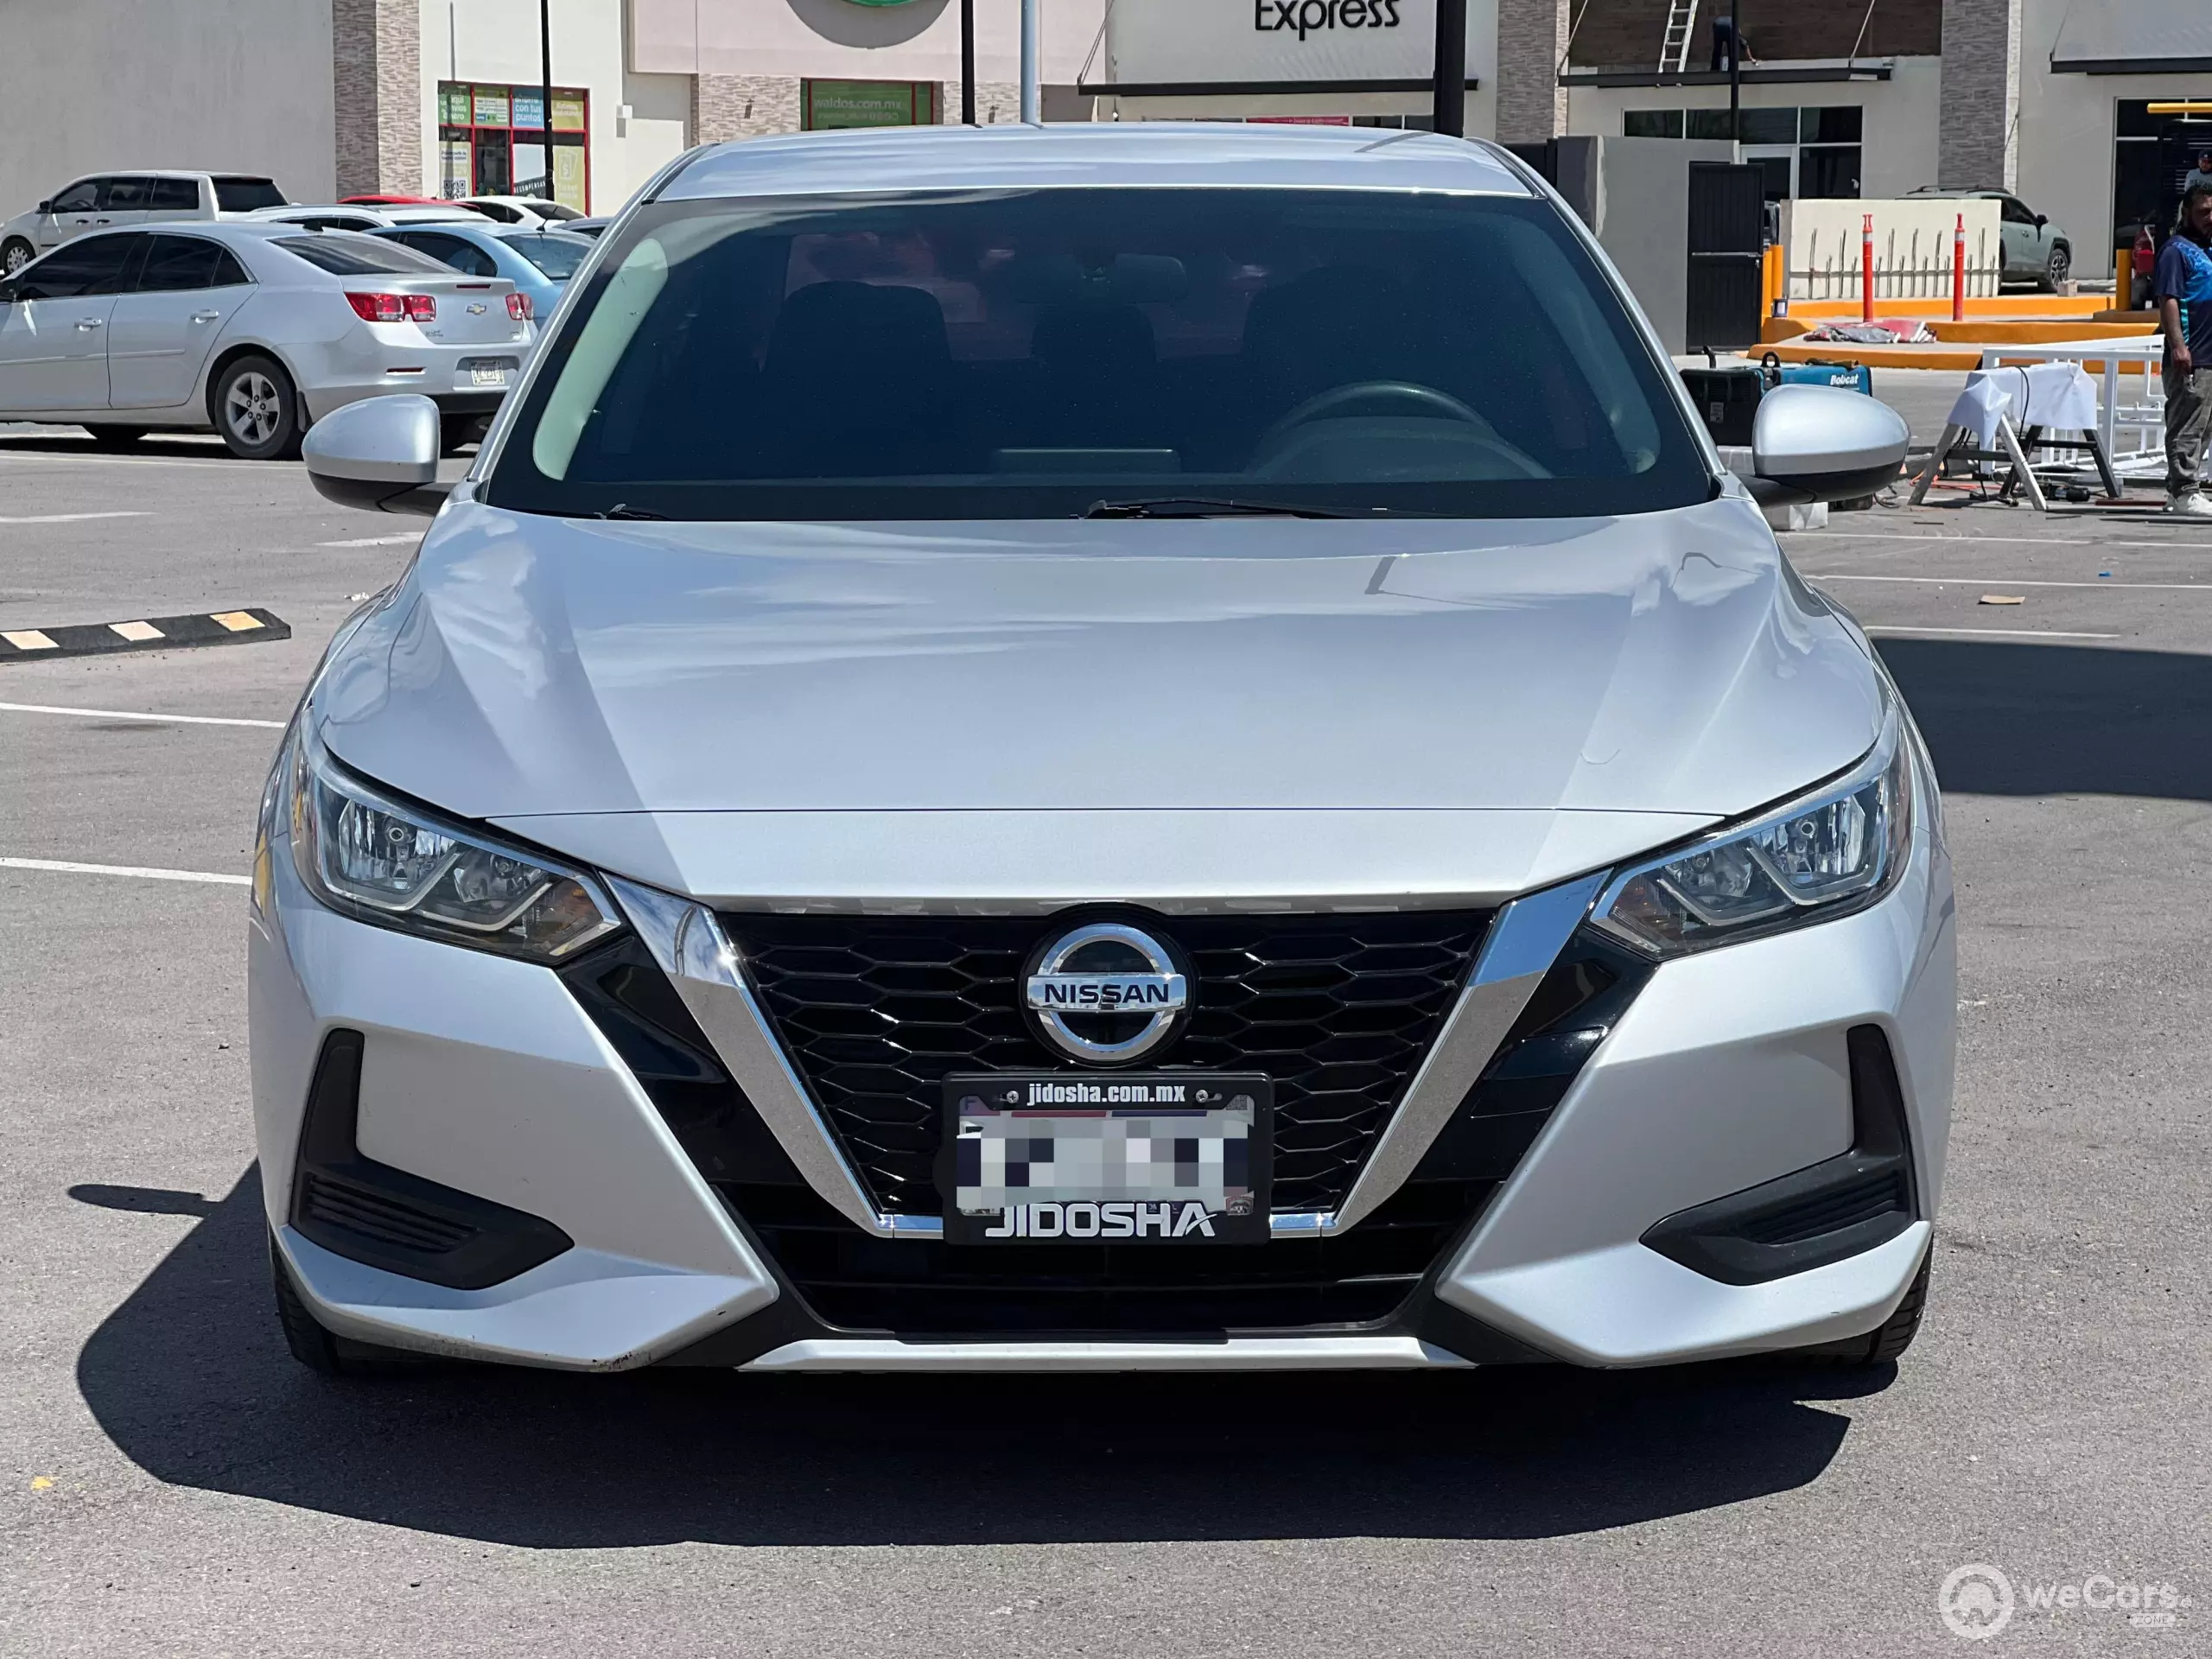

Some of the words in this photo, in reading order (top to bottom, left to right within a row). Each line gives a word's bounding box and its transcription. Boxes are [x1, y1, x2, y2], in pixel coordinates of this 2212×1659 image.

[1255, 0, 1400, 41] Express
[814, 97, 902, 110] waldos.com.mx
[1830, 373, 1859, 385] Bobcat
[1044, 983, 1170, 1004] NISSAN
[1027, 1083, 1185, 1106] jidosha.com.mx
[985, 1202, 1217, 1237] JIDOSHA
